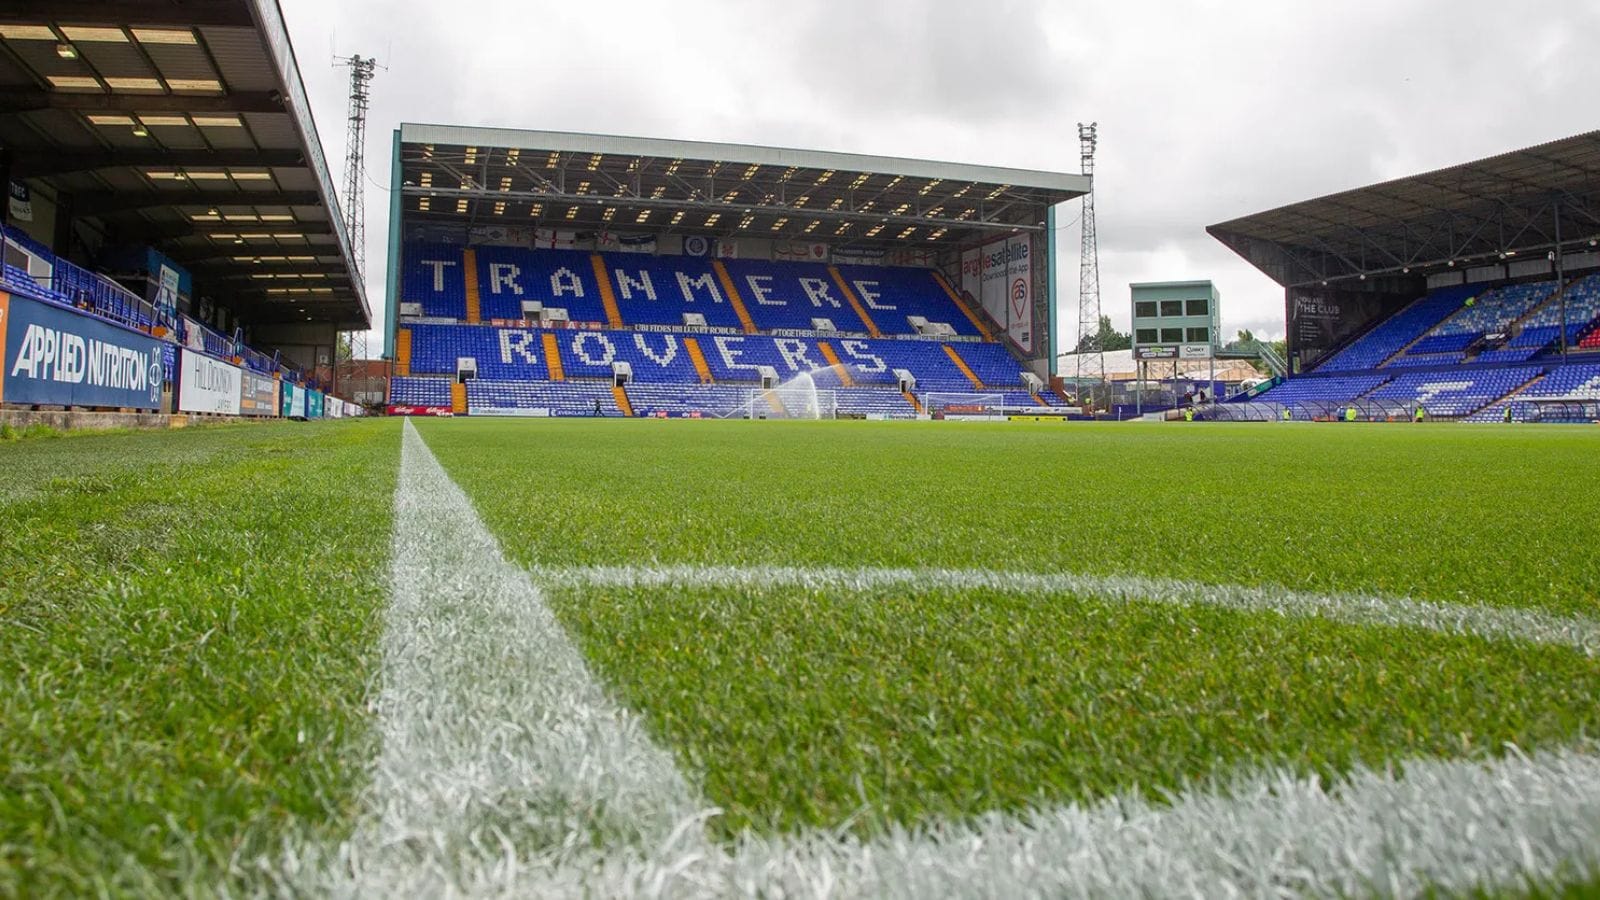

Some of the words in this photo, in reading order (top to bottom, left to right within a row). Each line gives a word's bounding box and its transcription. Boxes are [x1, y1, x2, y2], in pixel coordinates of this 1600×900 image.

[421, 259, 897, 311] TRANMERE
[11, 323, 86, 384] APPLIED
[87, 338, 148, 391] NUTRITION
[498, 329, 887, 373] ROVERS
